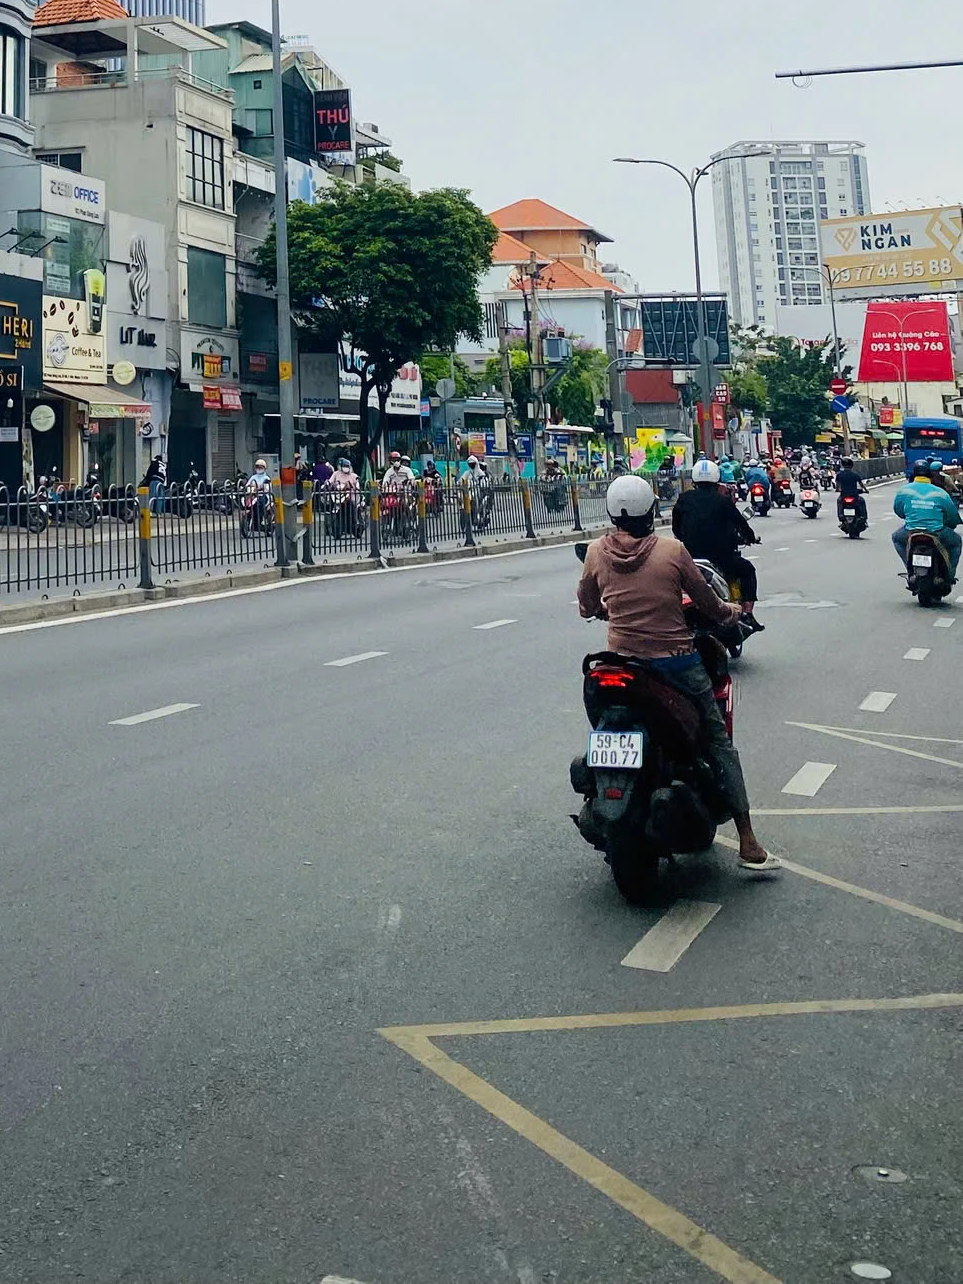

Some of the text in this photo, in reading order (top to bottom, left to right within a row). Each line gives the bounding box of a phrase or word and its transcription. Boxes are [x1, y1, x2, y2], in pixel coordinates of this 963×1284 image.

[317, 104, 349, 124] THÚ
[327, 125, 338, 140] Y
[318, 141, 349, 150] PROCARE
[74, 186, 99, 204] OFFICE
[861, 223, 892, 237] KIM
[3, 316, 33, 338] HERI
[72, 347, 88, 357] Coffee
[93, 349, 101, 358] Tea
[871, 343, 891, 352] 093
[924, 341, 944, 351] 768
[6, 373, 18, 387] SI
